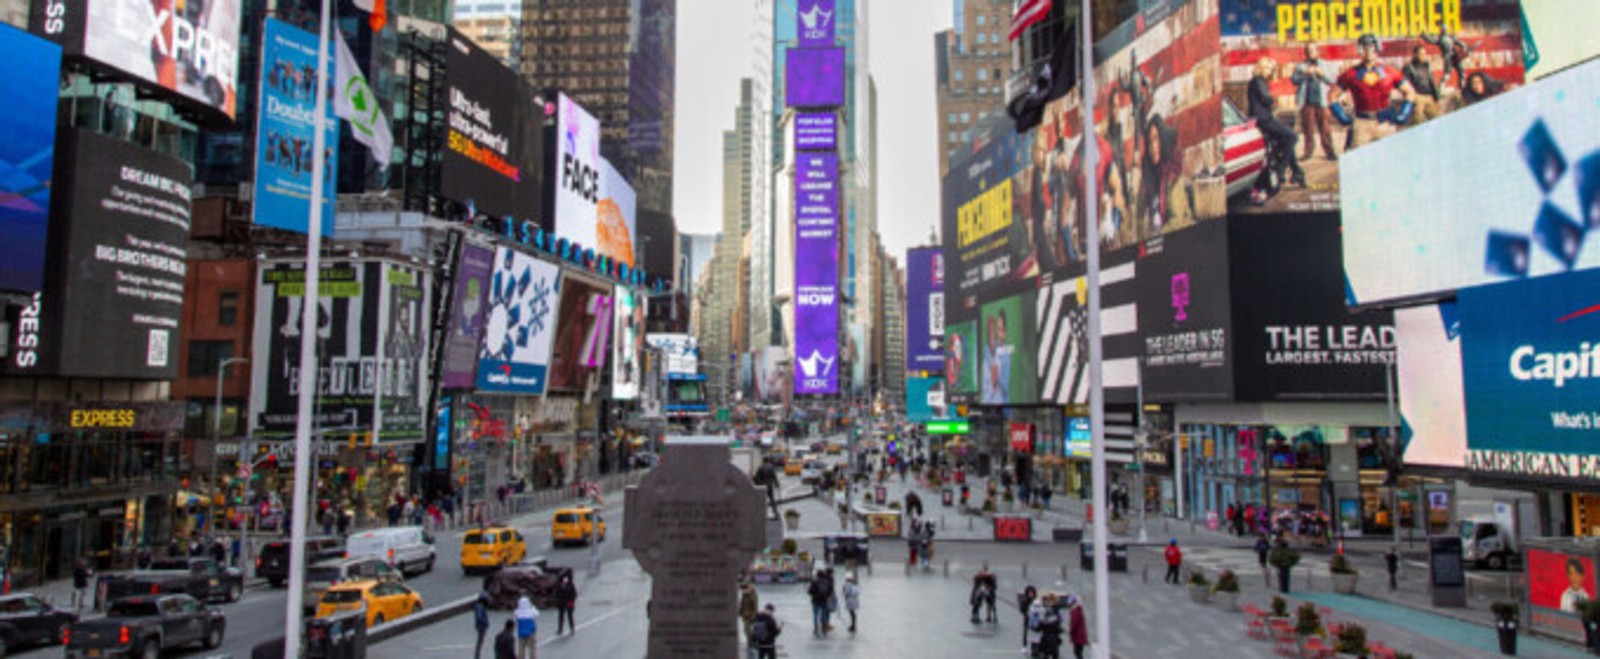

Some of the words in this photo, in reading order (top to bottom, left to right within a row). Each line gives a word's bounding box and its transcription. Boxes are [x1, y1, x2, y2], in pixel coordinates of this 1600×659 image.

[1276, 0, 1461, 43] PEACEMAKER
[562, 154, 600, 204] FACE
[798, 294, 835, 305] NOW
[1265, 326, 1320, 350] THE
[70, 410, 135, 428] EXPRESS
[1550, 411, 1592, 429] What's
[1465, 450, 1580, 476] AMERICAN
